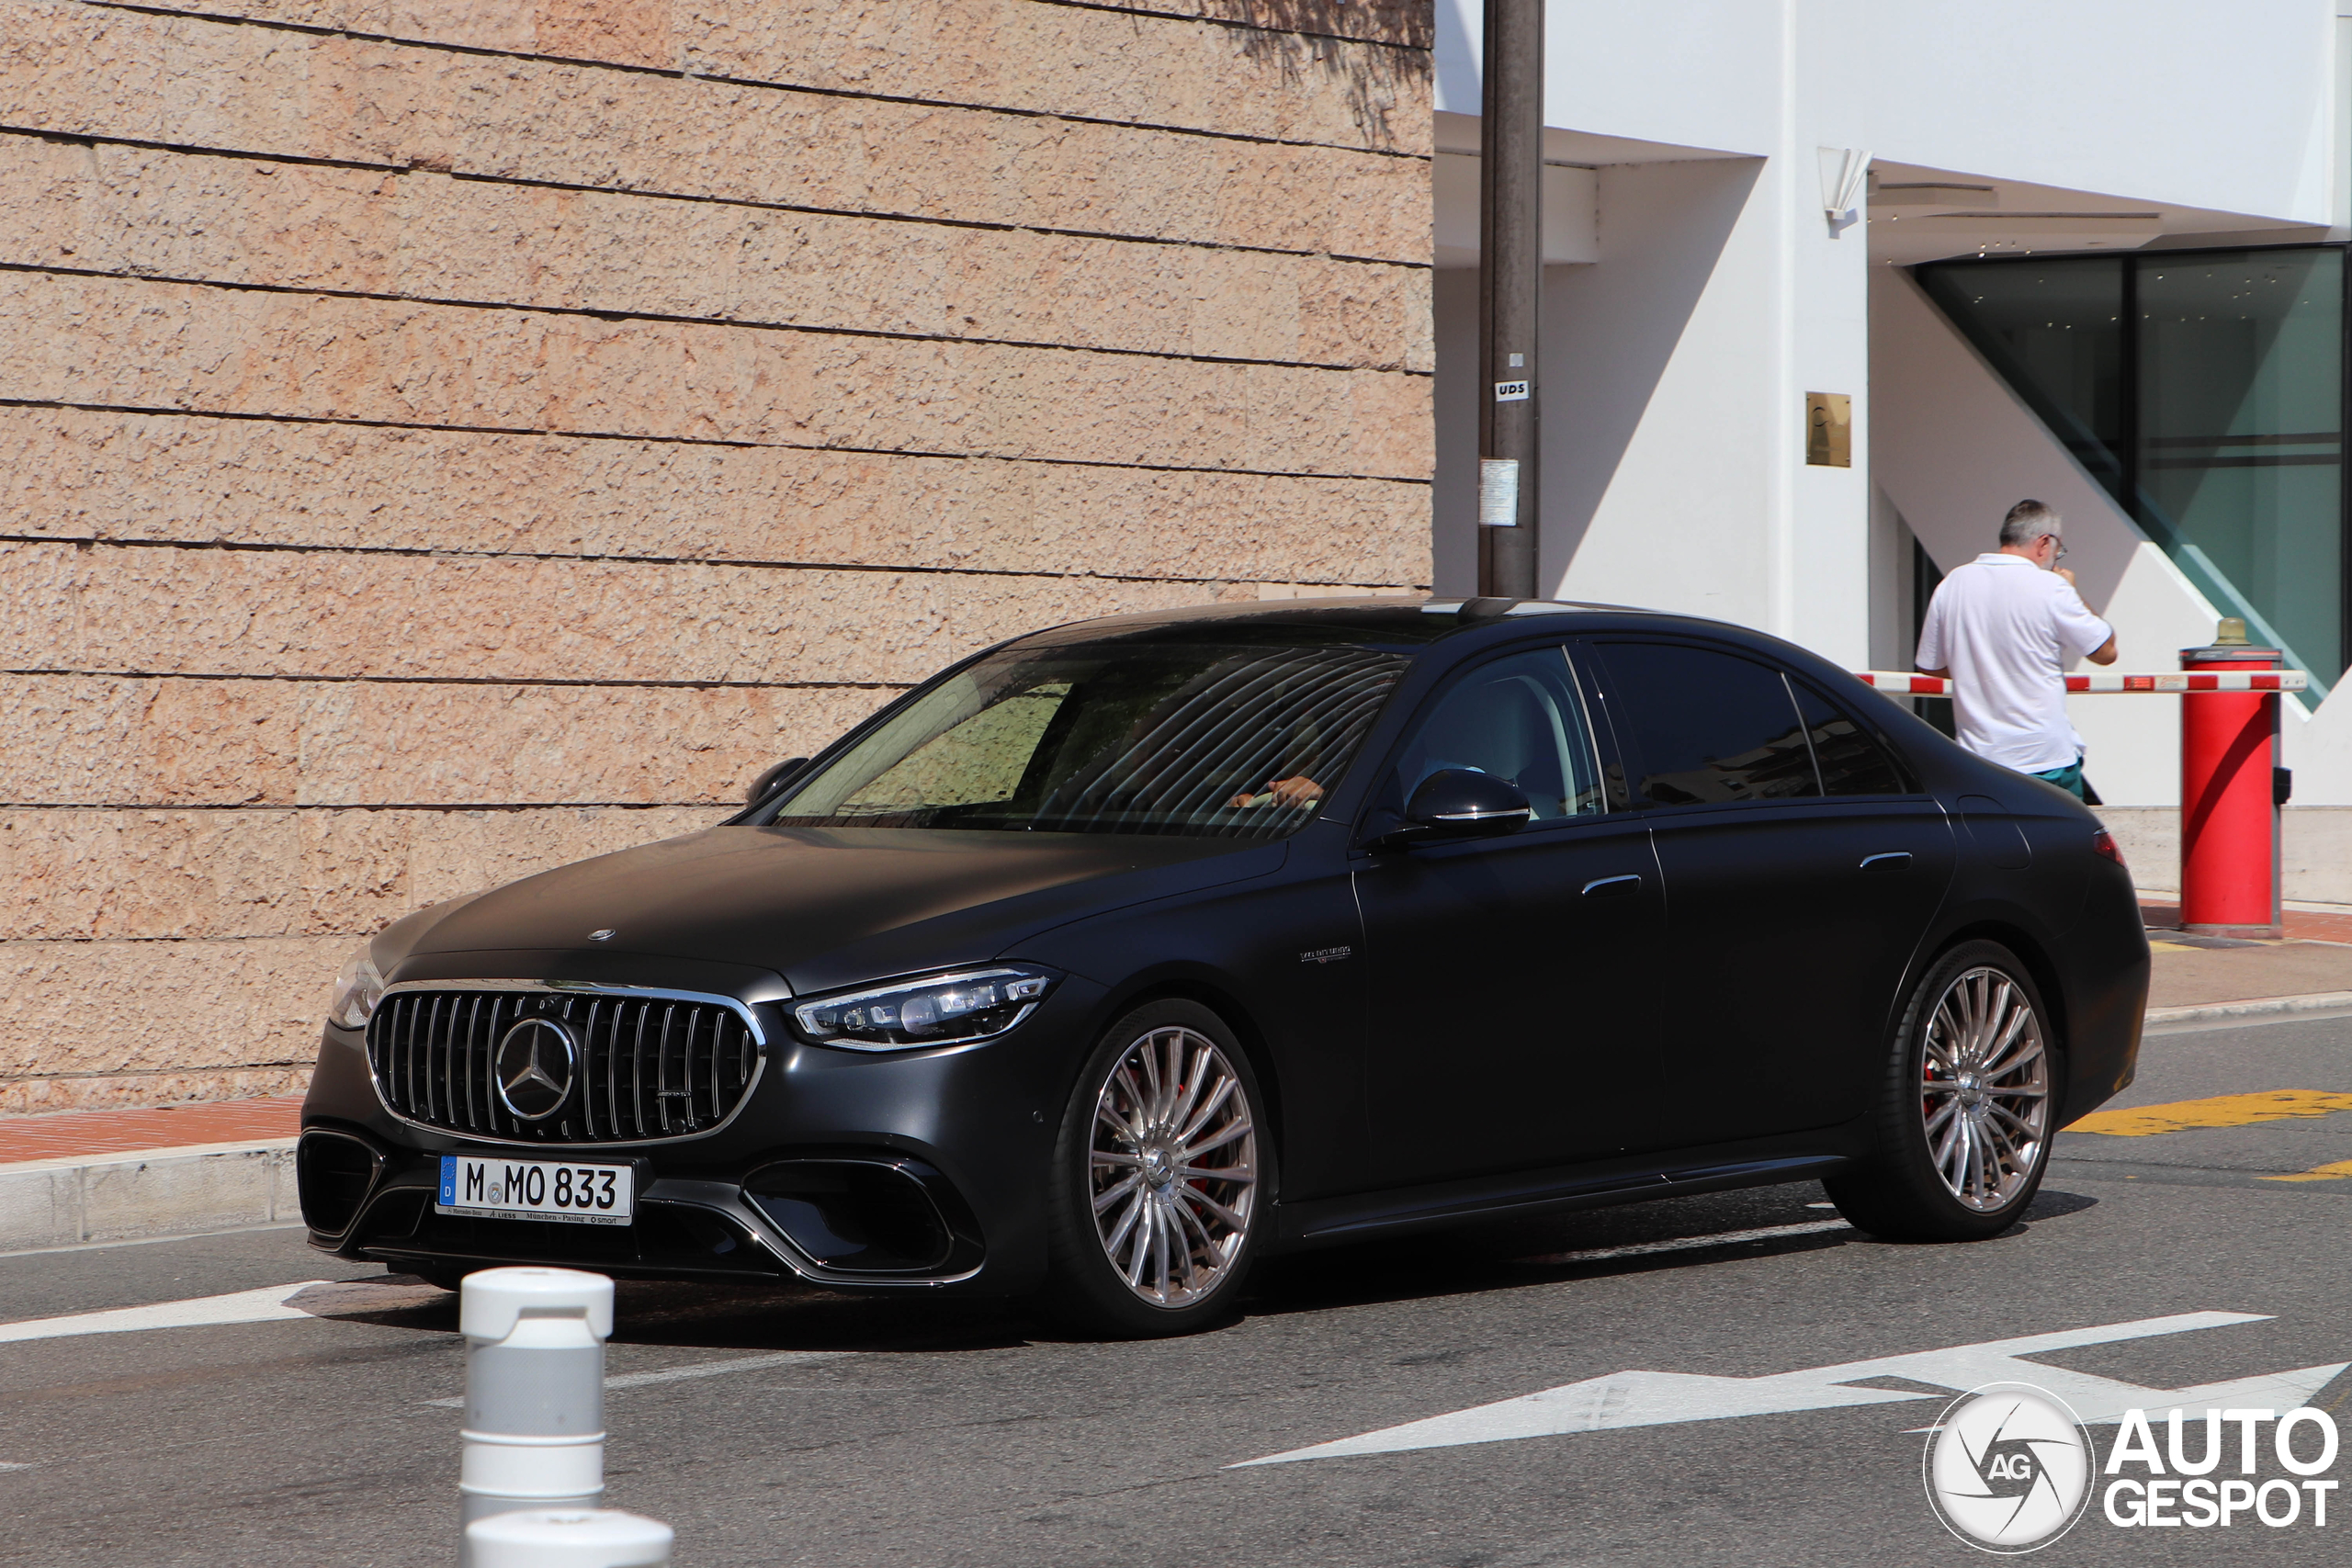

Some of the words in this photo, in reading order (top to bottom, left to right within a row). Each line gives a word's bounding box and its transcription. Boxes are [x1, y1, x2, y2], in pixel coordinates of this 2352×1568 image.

[1499, 384, 1525, 395] UDS
[445, 1186, 451, 1197] D
[467, 1162, 484, 1201] M
[504, 1165, 545, 1206] MO
[554, 1168, 616, 1210] 833
[526, 1213, 557, 1221] München
[562, 1214, 585, 1223] Pasing
